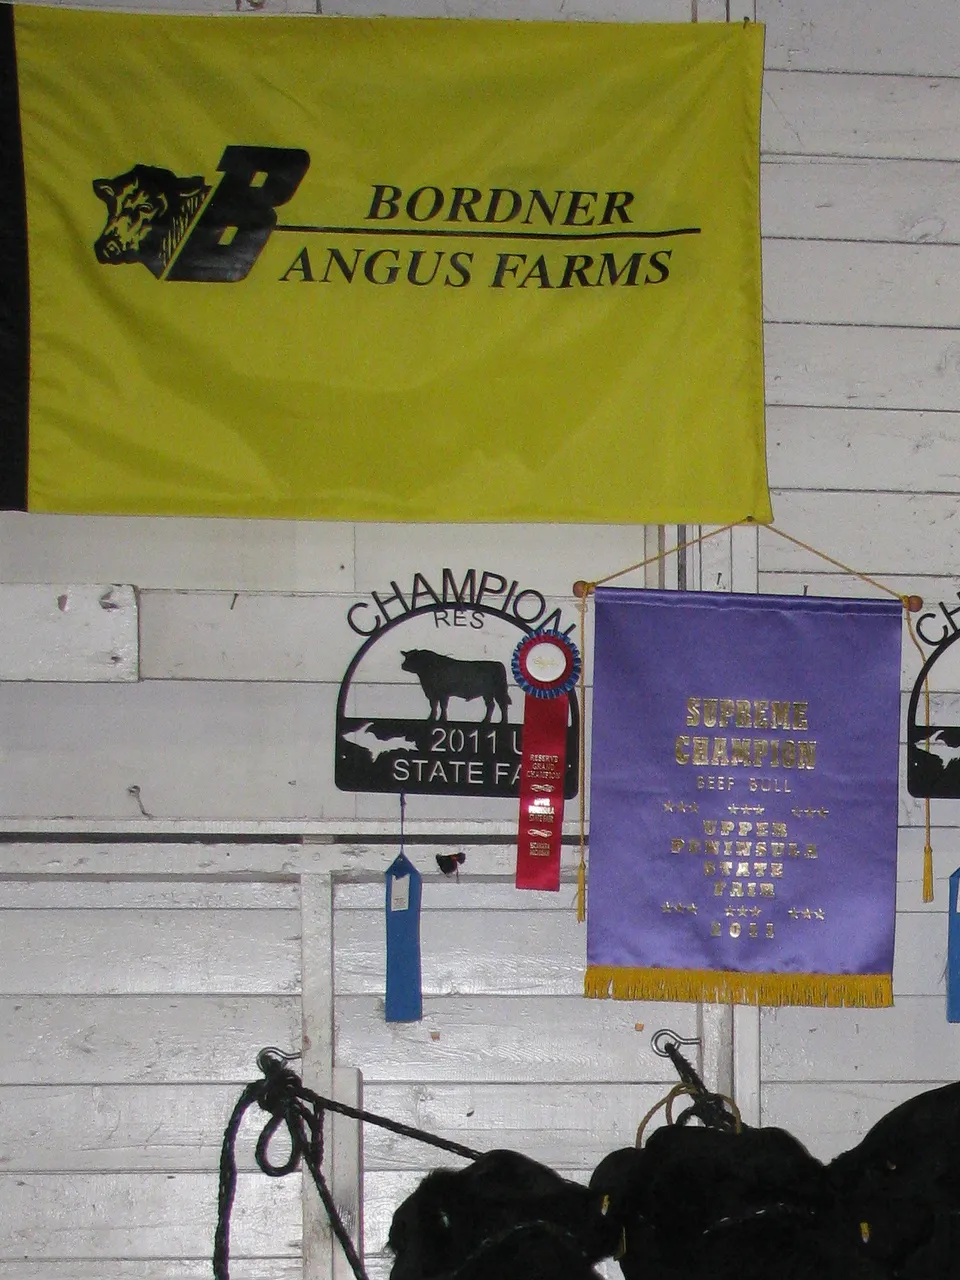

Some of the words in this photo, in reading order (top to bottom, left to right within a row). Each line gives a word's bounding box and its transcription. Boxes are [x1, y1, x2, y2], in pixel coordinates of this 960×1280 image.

[365, 184, 636, 226] BORDNER
[279, 247, 473, 288] ANGUS
[488, 249, 673, 289] FARMS
[434, 611, 485, 630] RES
[686, 697, 809, 731] SUPREME
[431, 728, 497, 754] 2011
[675, 736, 817, 769] CHAMPION
[393, 759, 484, 783] STATE
[697, 776, 735, 791] BEEF
[750, 777, 792, 793] BULL
[703, 820, 788, 837] UPPER
[671, 838, 819, 859] PENINSULA
[704, 862, 783, 878] STATE
[714, 882, 775, 897] FAIR
[710, 922, 774, 939] 2011
